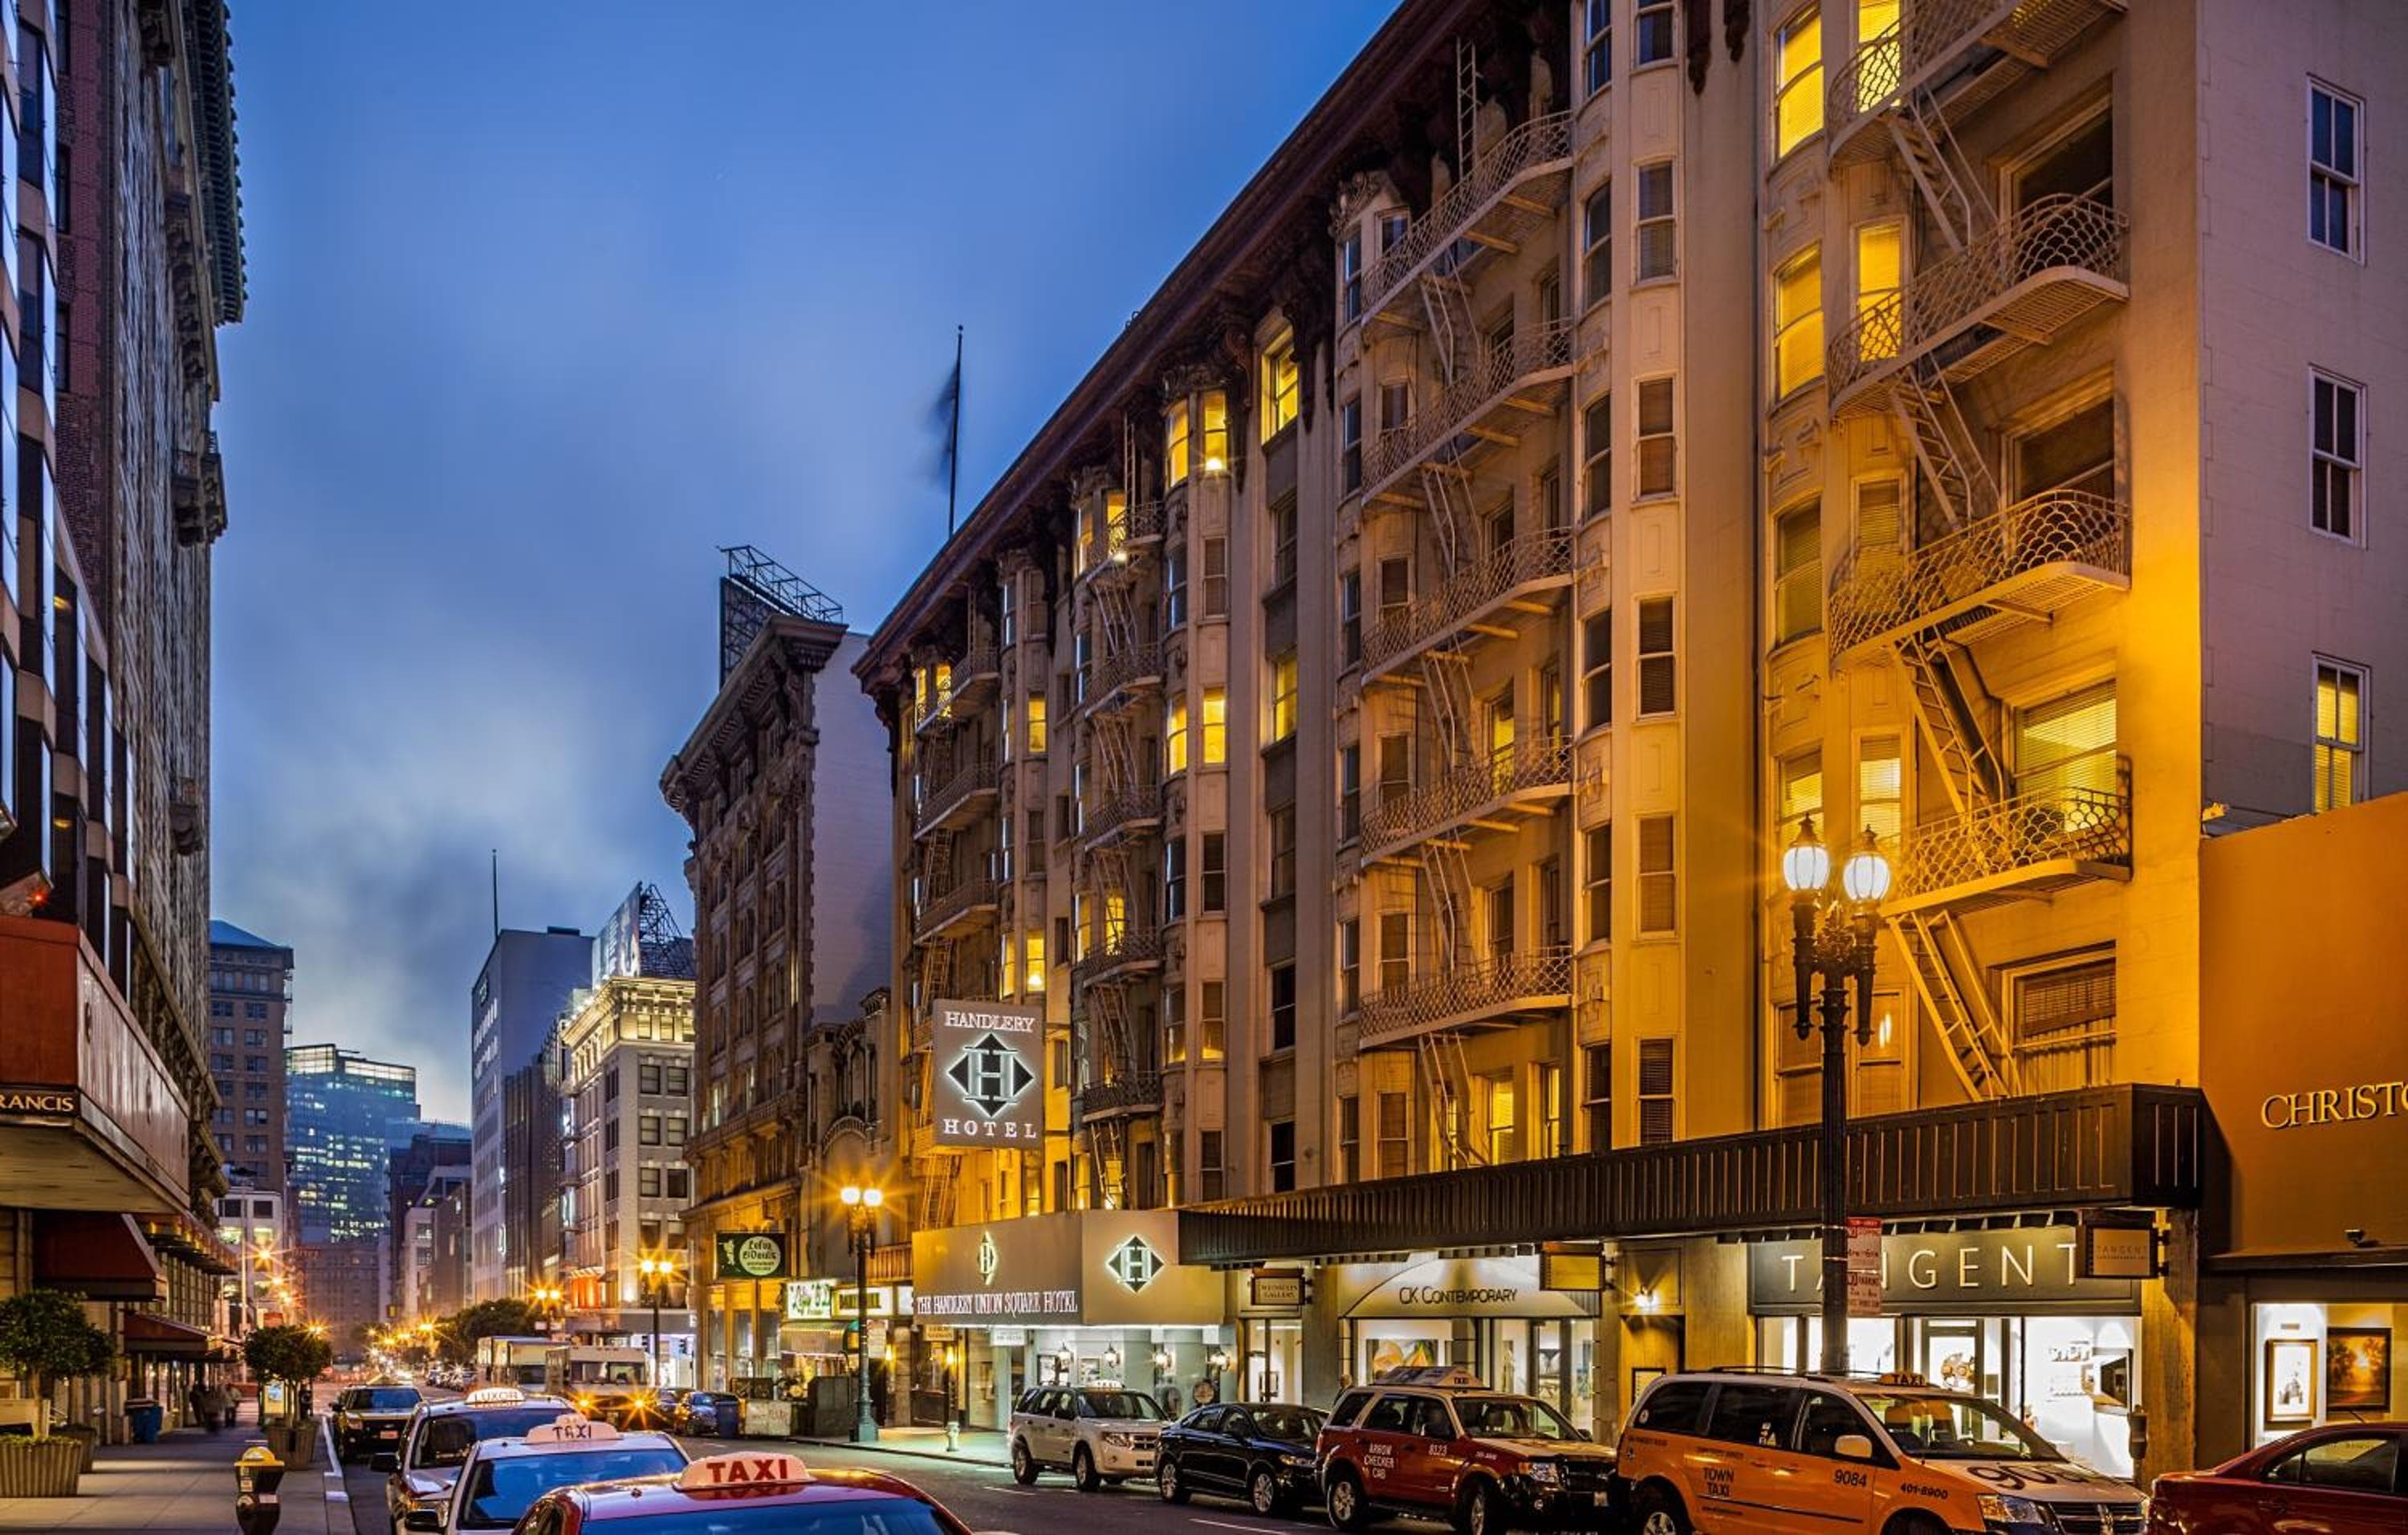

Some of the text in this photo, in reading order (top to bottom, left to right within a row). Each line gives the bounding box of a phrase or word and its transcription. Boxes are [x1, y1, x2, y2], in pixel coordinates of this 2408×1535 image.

[944, 1011, 1035, 1032] HANDLERY
[2261, 1081, 2408, 1129] CHRIST
[943, 1118, 1037, 1138] HOTEL
[1399, 1286, 1418, 1305] CK
[917, 1290, 1078, 1317] THE HANDLERY UNION SQUARE HOTEL
[1892, 1374, 1925, 1385] TAXI
[474, 1391, 519, 1401] LUXOR
[552, 1424, 592, 1439] TAXI
[1369, 1443, 1392, 1455] ARROW
[1364, 1456, 1394, 1468] CHECKER
[706, 1459, 789, 1484] TAXI
[1373, 1468, 1386, 1480] CAB
[1703, 1468, 1735, 1483] TOWN
[1835, 1469, 1867, 1487] 9084
[1707, 1482, 1730, 1497] TAXI
